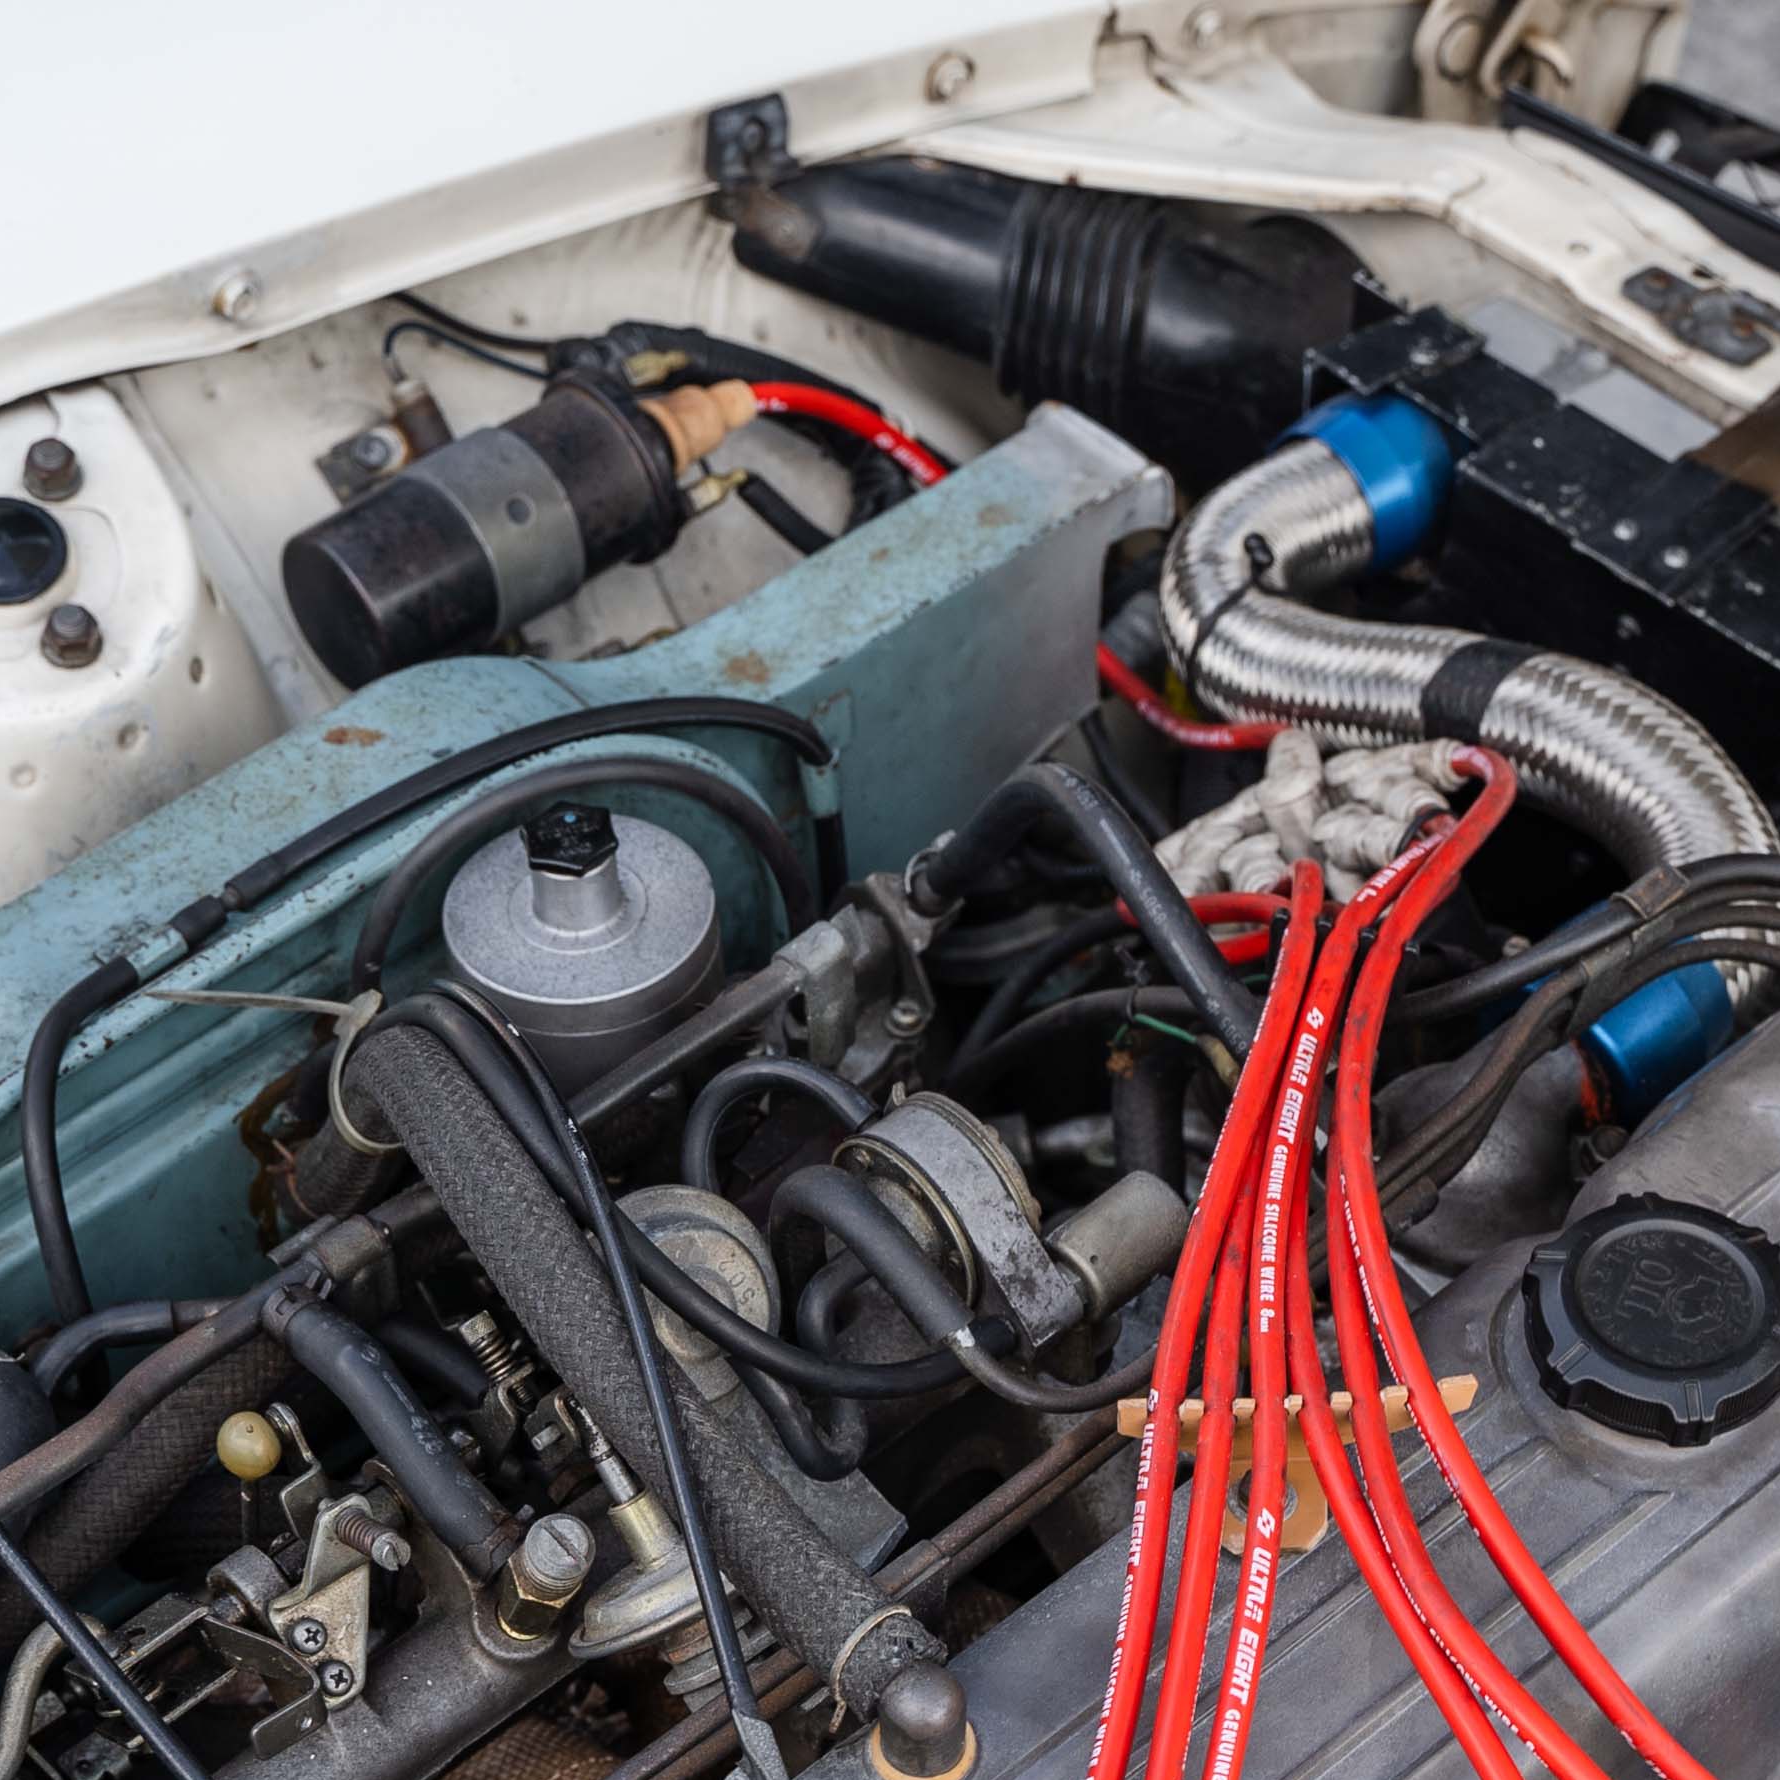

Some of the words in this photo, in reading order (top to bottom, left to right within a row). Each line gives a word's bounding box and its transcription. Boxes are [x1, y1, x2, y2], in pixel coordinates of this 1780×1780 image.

[1290, 1032, 1318, 1083] ULTRA
[1277, 1088, 1304, 1146] EIGHT
[1266, 1144, 1290, 1203] GENUINE
[1261, 1203, 1281, 1264] SILICONE
[1259, 1265, 1276, 1304] WIRE
[1135, 1422, 1156, 1492] ULTRA
[1129, 1500, 1148, 1568] EIGHT
[1115, 1572, 1135, 1643] GENUINE
[1244, 1544, 1274, 1625] ULTRA
[1101, 1645, 1124, 1716] SILICONE
[1227, 1626, 1261, 1708] EIGHT
[1088, 1719, 1110, 1769] WIRE
